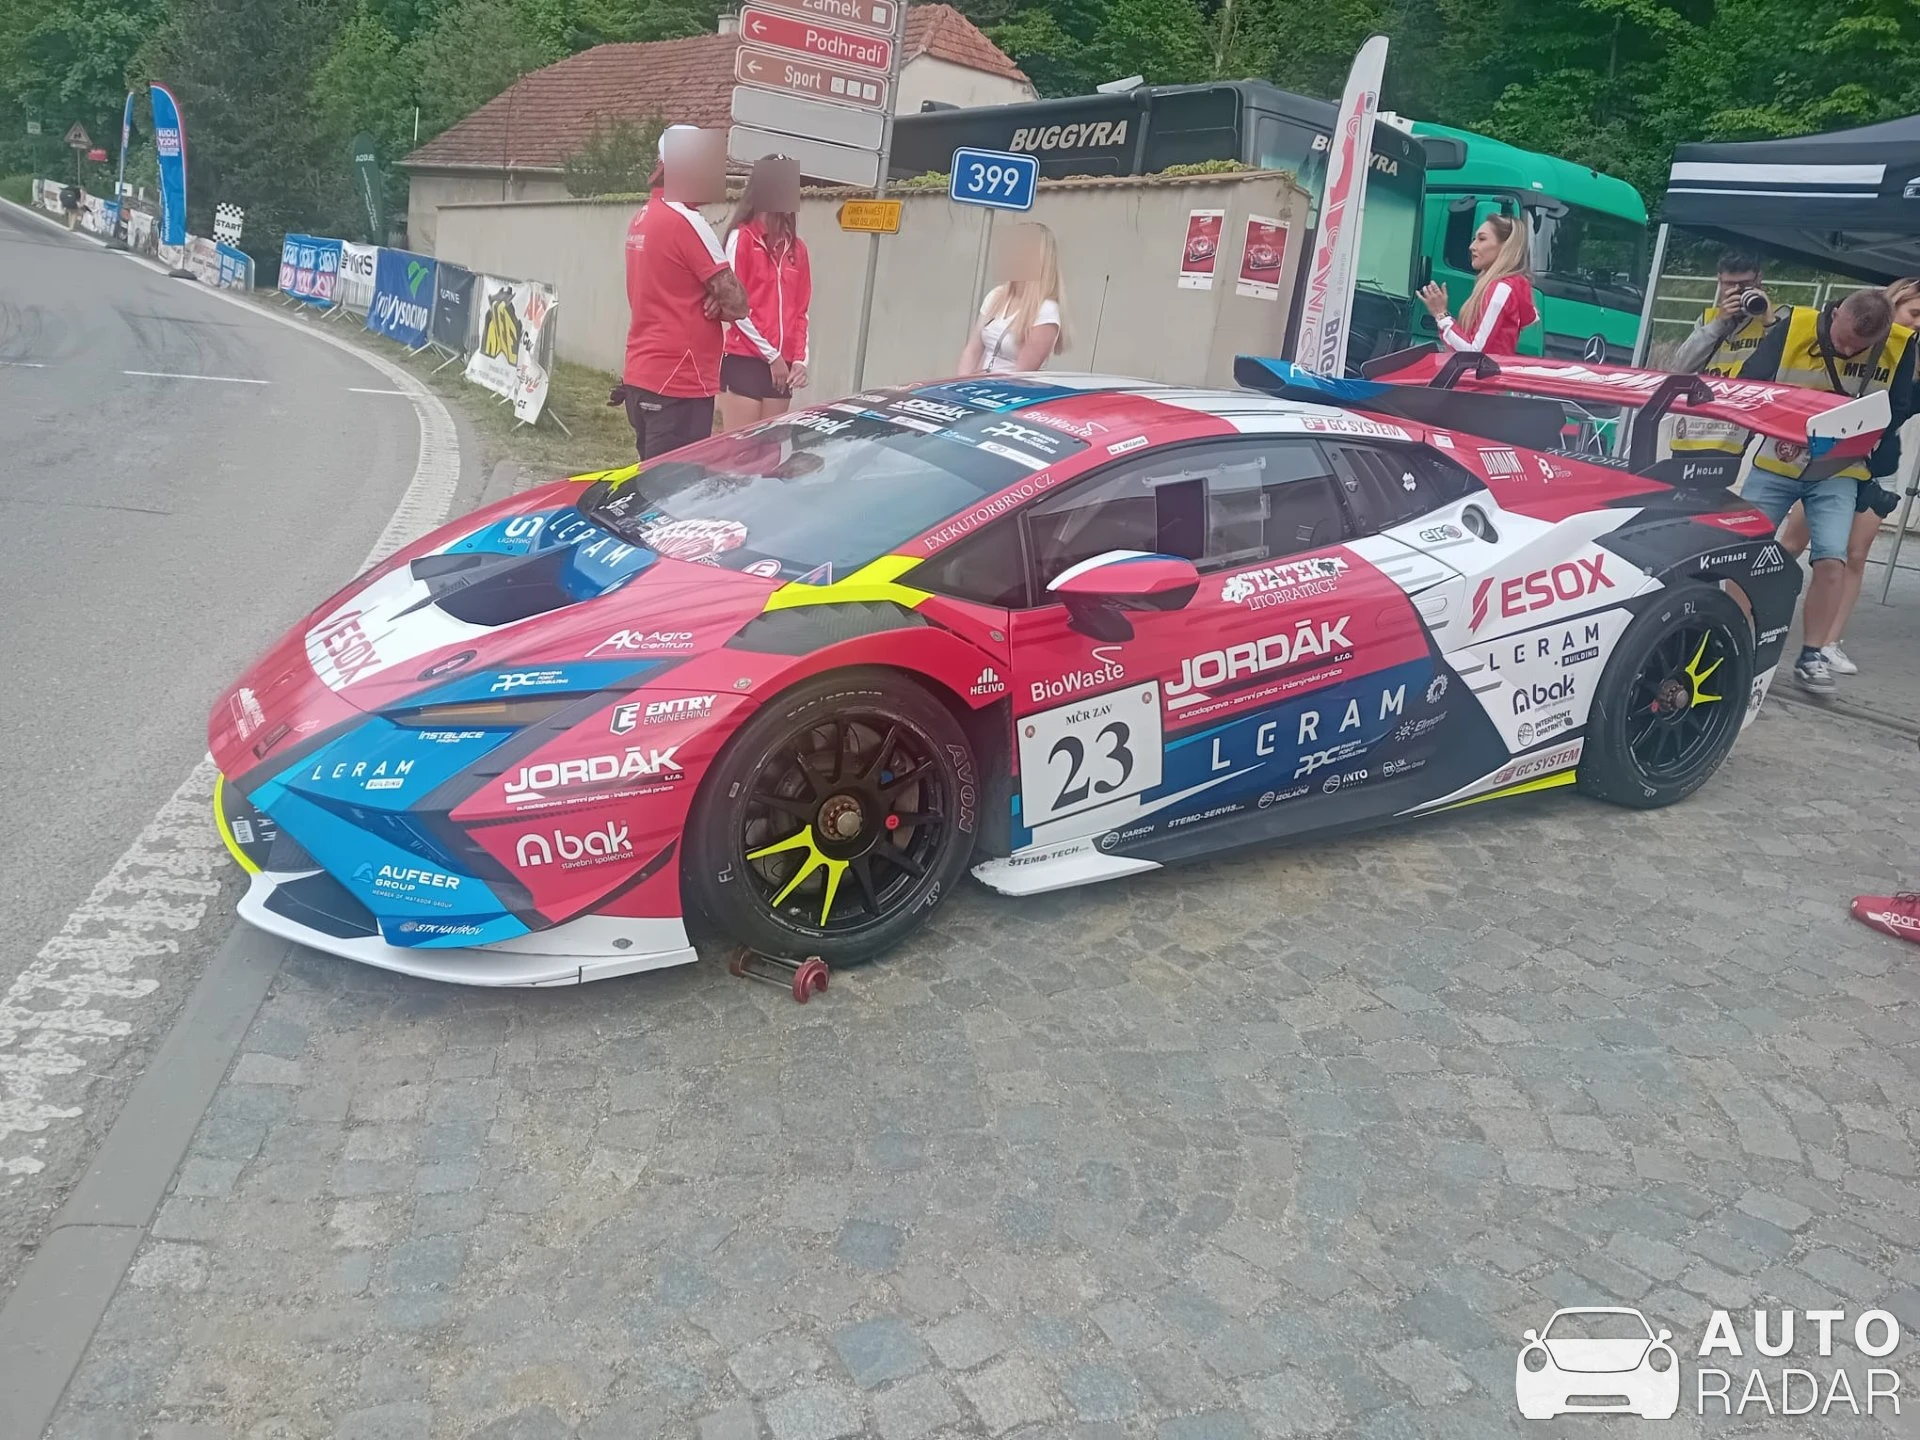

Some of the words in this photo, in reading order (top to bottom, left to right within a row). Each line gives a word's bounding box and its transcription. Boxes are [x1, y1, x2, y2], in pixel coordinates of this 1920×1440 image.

[805, 29, 883, 63] Podhradí
[784, 65, 821, 89] Sport
[1010, 120, 1128, 152] BUGGYRA
[967, 163, 1019, 196] 399
[215, 219, 241, 232] START
[1843, 363, 1890, 383] MEIA
[1023, 411, 1093, 437] BioWaste
[1328, 418, 1347, 431] GC
[1349, 420, 1400, 437] SYSTEM
[923, 473, 1055, 550] EXEKUTORBRNO.CZ
[549, 512, 636, 568] LERAM
[1711, 552, 1747, 565] KAITRADE
[1501, 553, 1616, 618] ESOX
[1684, 601, 1697, 616] RL
[641, 641, 694, 650] centrum
[645, 631, 693, 642] Agro
[1489, 622, 1600, 672] LERAM
[322, 618, 382, 685] ESOX
[1564, 650, 1598, 665] BUILDING
[969, 682, 1005, 696] HELIVO
[1030, 663, 1125, 702] BioWaste
[645, 694, 718, 716] ENTRY
[644, 709, 711, 726] ENGINEERING
[1065, 710, 1091, 725] MČR
[1211, 684, 1406, 771] LERAM
[311, 759, 415, 781] LERAM
[1047, 721, 1134, 812] 23
[1516, 763, 1533, 776] GC
[1534, 747, 1580, 772] SYSTEM
[947, 744, 977, 834] AVON
[1121, 825, 1155, 838] KARSCH
[561, 859, 593, 870] stavební
[595, 851, 634, 864] společnost
[378, 865, 461, 890] AUFEER
[718, 862, 732, 883] FL
[375, 879, 416, 892] GROUP
[372, 890, 395, 898] MEMBER
[405, 895, 431, 905] MATADOR
[433, 901, 453, 909] GROUP
[415, 923, 435, 932] STK
[438, 924, 484, 935] HAVÍŘOV
[1882, 911, 1920, 927] spar
